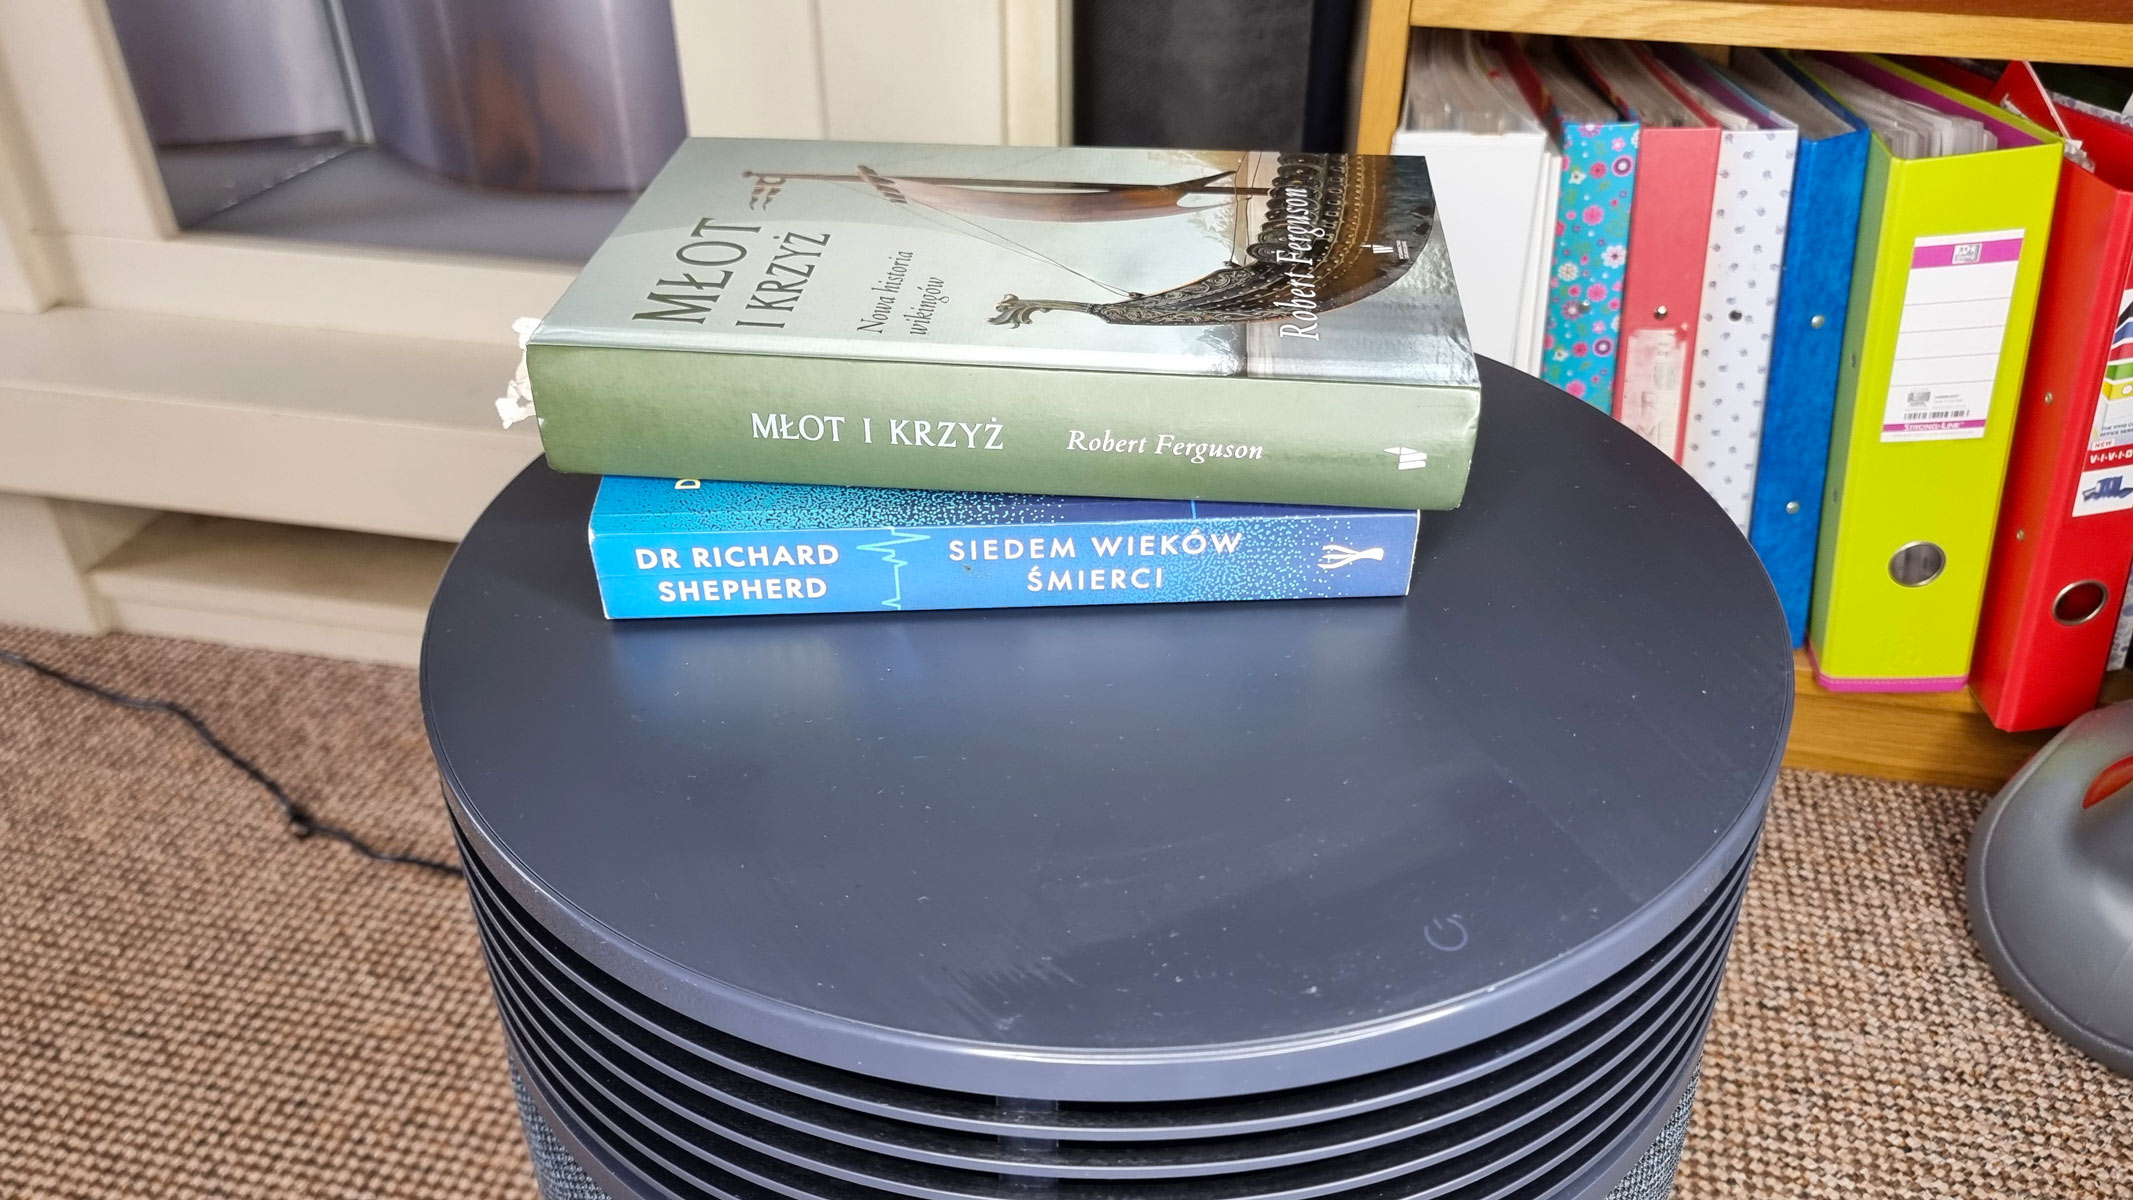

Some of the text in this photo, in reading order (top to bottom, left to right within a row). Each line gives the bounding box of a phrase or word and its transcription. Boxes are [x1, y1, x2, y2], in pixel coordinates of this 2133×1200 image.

[632, 217, 762, 325] MŁOT
[735, 232, 831, 329] I KRZYŻ
[1273, 187, 1326, 342] Robert Ferguson
[857, 251, 914, 334] Nowa historia
[903, 276, 950, 335] wikingów
[751, 412, 1004, 450] MŁOT I KRZYŻ
[1066, 430, 1264, 464] Robert Ferguson
[2095, 440, 2112, 448] NEW
[635, 543, 839, 569] DR RICHARD
[948, 529, 1243, 562] SIEDEM WIEKÓW
[657, 577, 827, 603] SHEPHERD
[1026, 564, 1164, 593] ŚMIERCI
